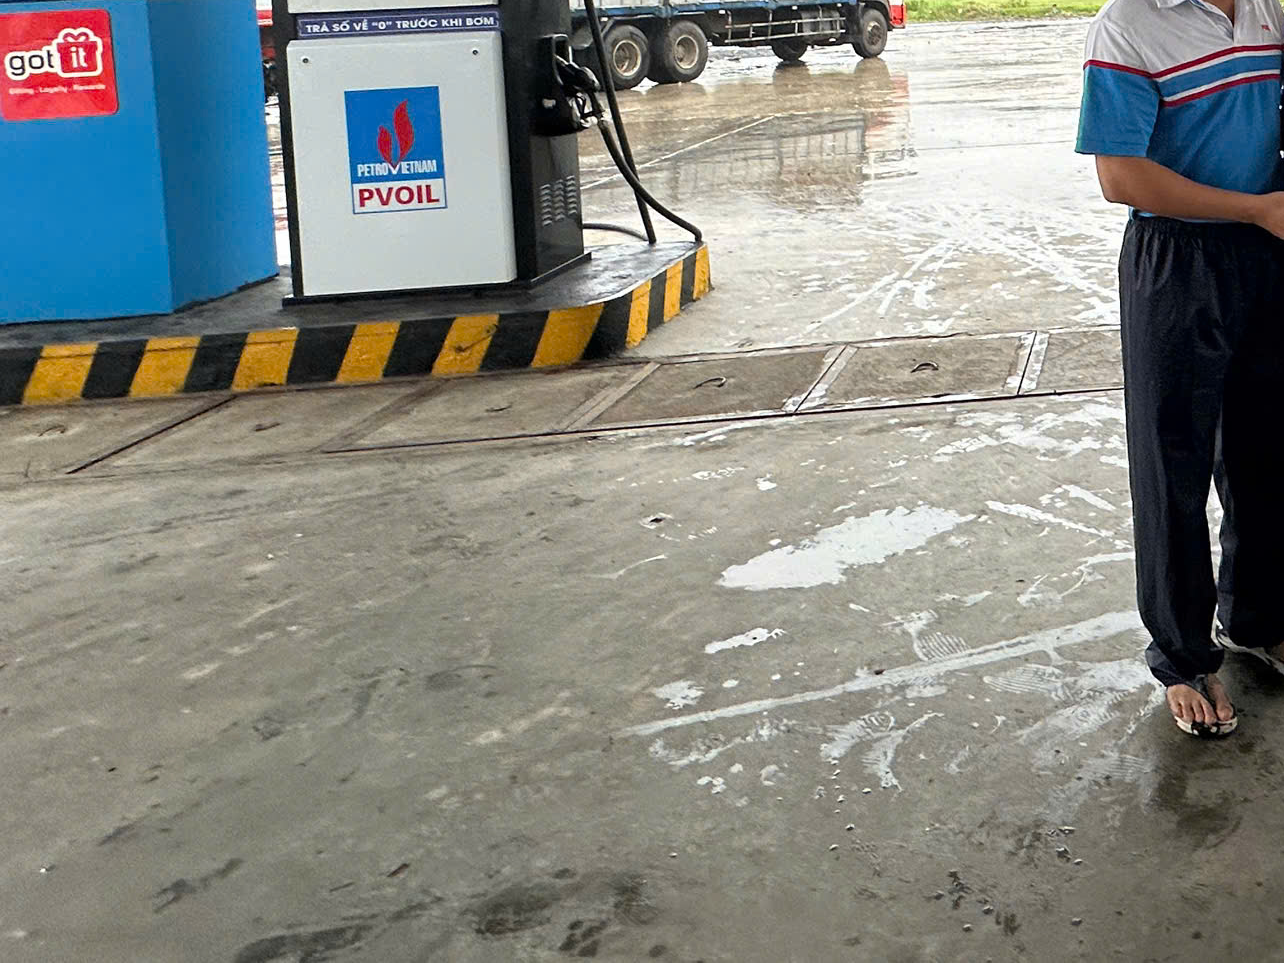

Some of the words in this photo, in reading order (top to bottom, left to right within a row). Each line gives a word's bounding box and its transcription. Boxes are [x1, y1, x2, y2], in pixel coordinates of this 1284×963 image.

[306, 21, 330, 32] TRẢ
[332, 20, 350, 31] SỐ
[353, 18, 368, 31] VỀ
[442, 18, 462, 27] KHI
[466, 16, 494, 26] BƠM
[9, 50, 54, 76] got
[70, 46, 88, 69] it
[358, 184, 440, 208] PVOIL
